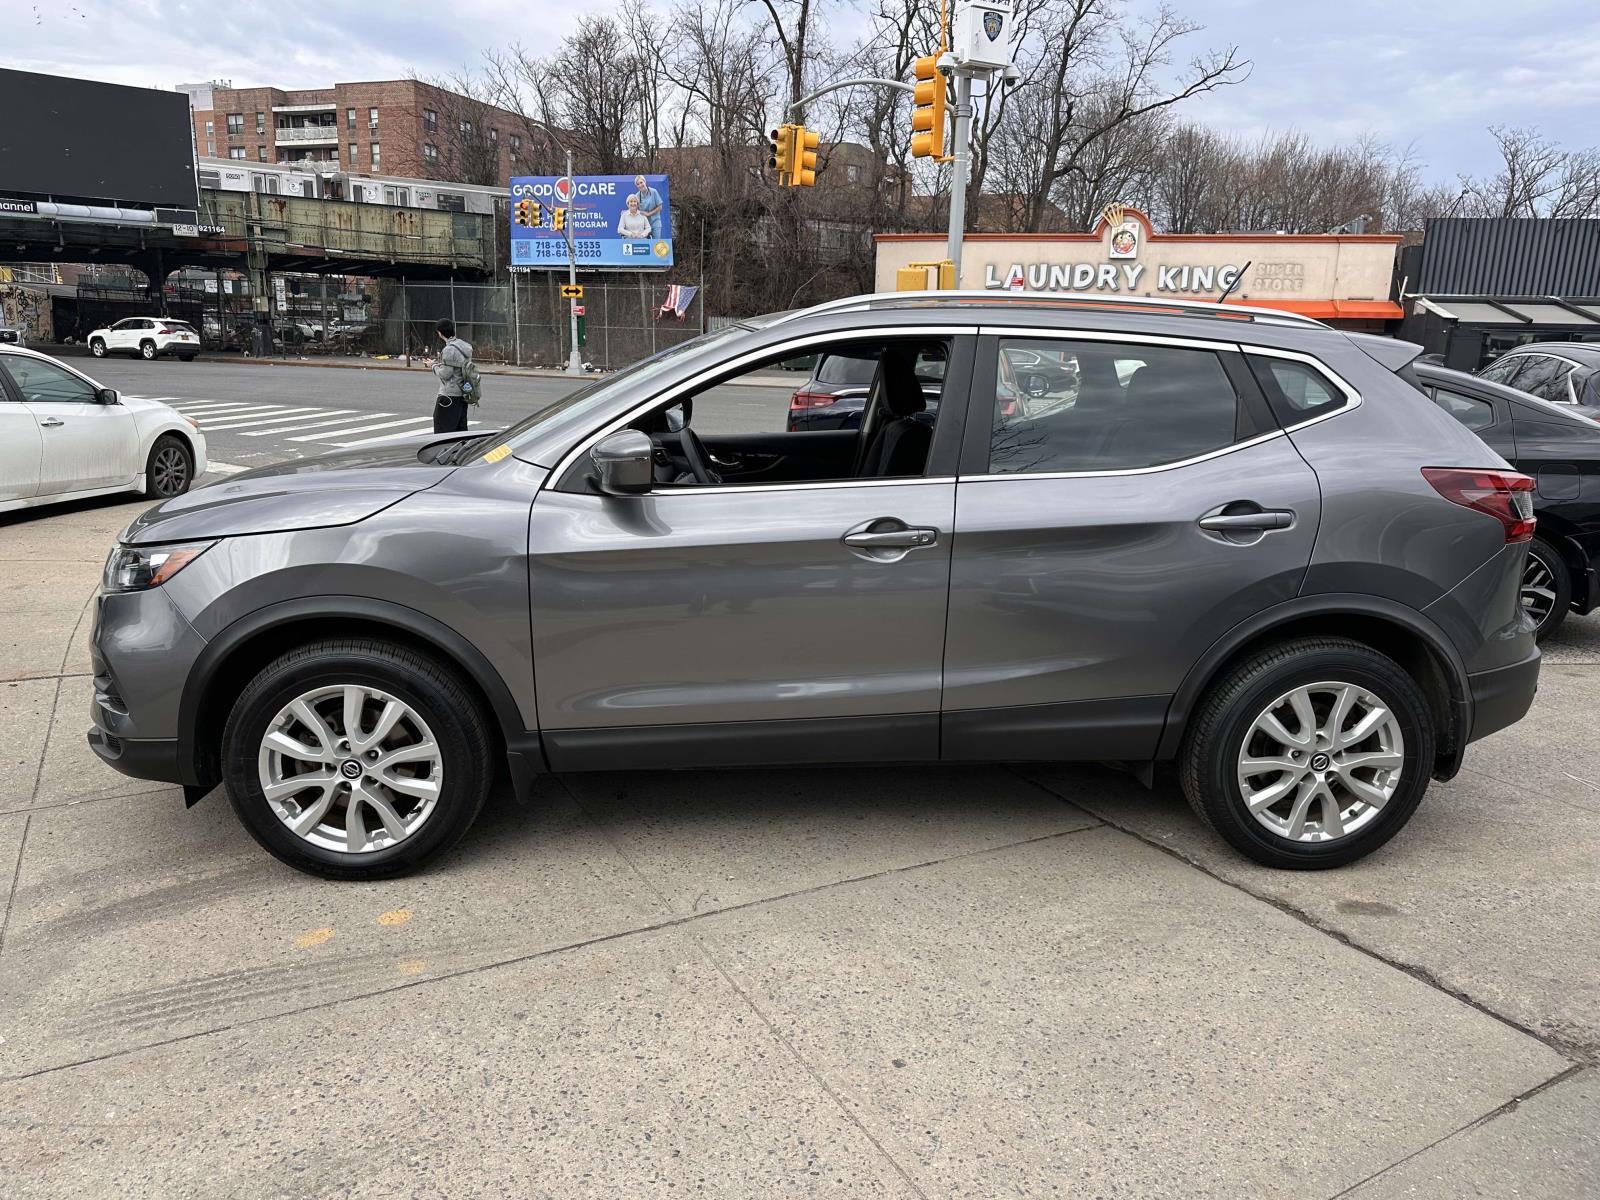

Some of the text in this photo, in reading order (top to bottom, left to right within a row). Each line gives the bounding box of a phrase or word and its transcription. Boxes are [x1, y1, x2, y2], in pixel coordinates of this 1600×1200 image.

[512, 182, 616, 196] GOOD CARE
[198, 225, 226, 233] 921164
[535, 241, 601, 249] 718-63-3535
[535, 249, 602, 258] 718-64-2020
[985, 262, 1144, 292] LAUNDRY
[1157, 264, 1240, 293] KING
[1252, 277, 1304, 291] STORE
